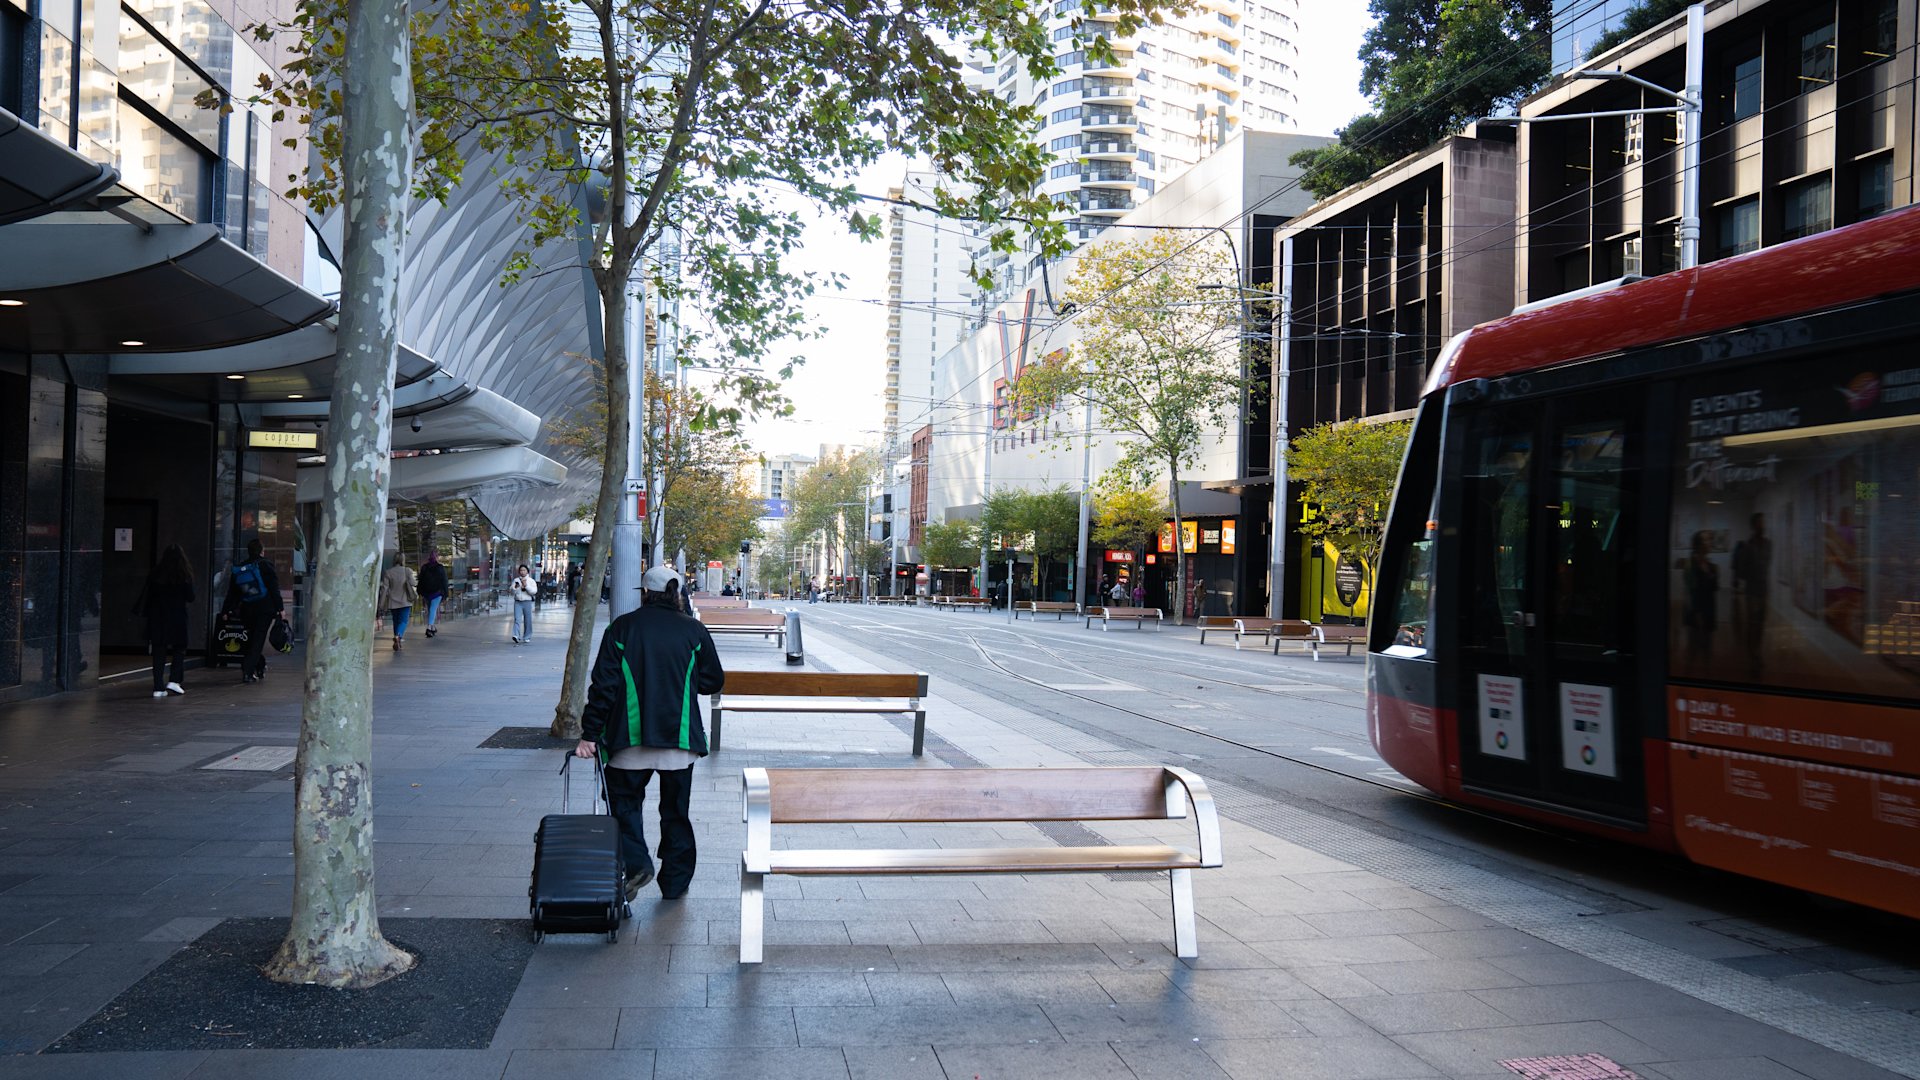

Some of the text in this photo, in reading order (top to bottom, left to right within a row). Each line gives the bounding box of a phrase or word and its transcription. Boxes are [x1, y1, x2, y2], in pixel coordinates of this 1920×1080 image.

[1690, 389, 1763, 416] EVENTS
[1688, 407, 1800, 438] THAT BRING
[1686, 440, 1723, 459] THE
[1688, 700, 1719, 716] DAY
[1689, 717, 1745, 736] DESERT
[1747, 724, 1786, 742] MOB
